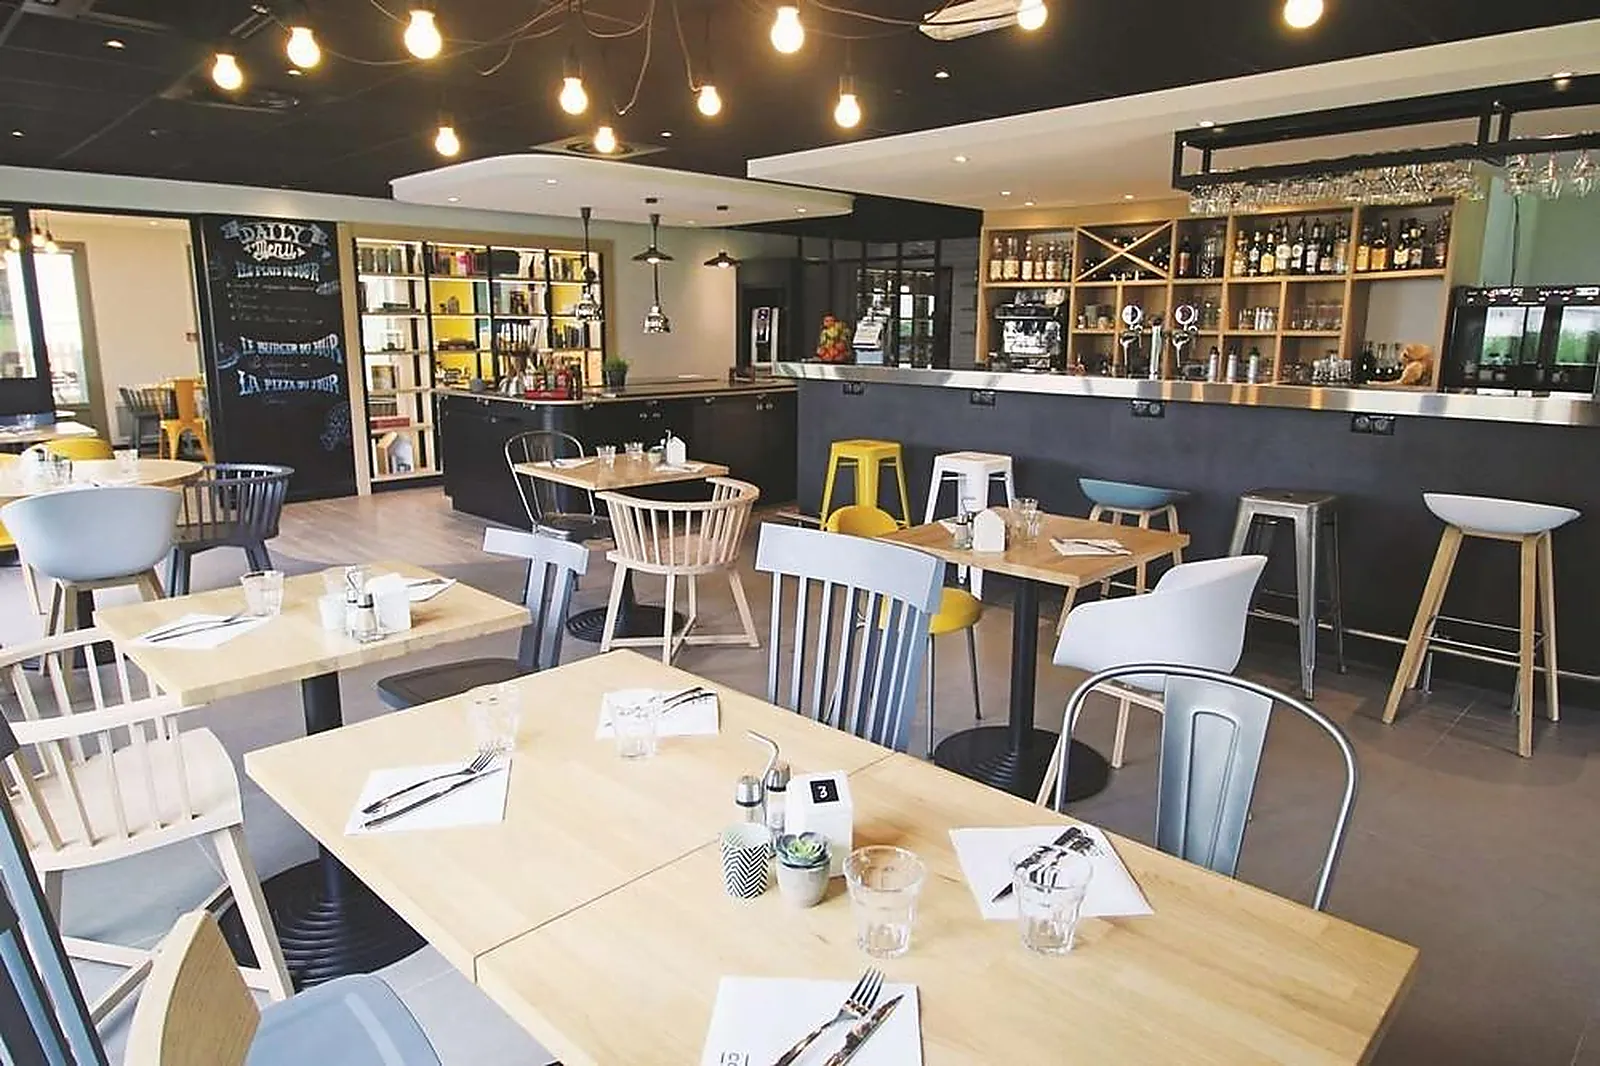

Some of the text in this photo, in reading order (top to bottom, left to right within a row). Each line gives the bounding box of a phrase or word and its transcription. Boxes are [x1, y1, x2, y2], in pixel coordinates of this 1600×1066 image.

[240, 222, 305, 245] DAILY
[240, 336, 256, 355] LE
[256, 341, 298, 355] BURGER
[312, 333, 343, 364] JOUR
[237, 369, 260, 396] LA
[263, 379, 296, 391] PIZZA
[311, 374, 340, 395] JOUR
[817, 785, 828, 799] 3
